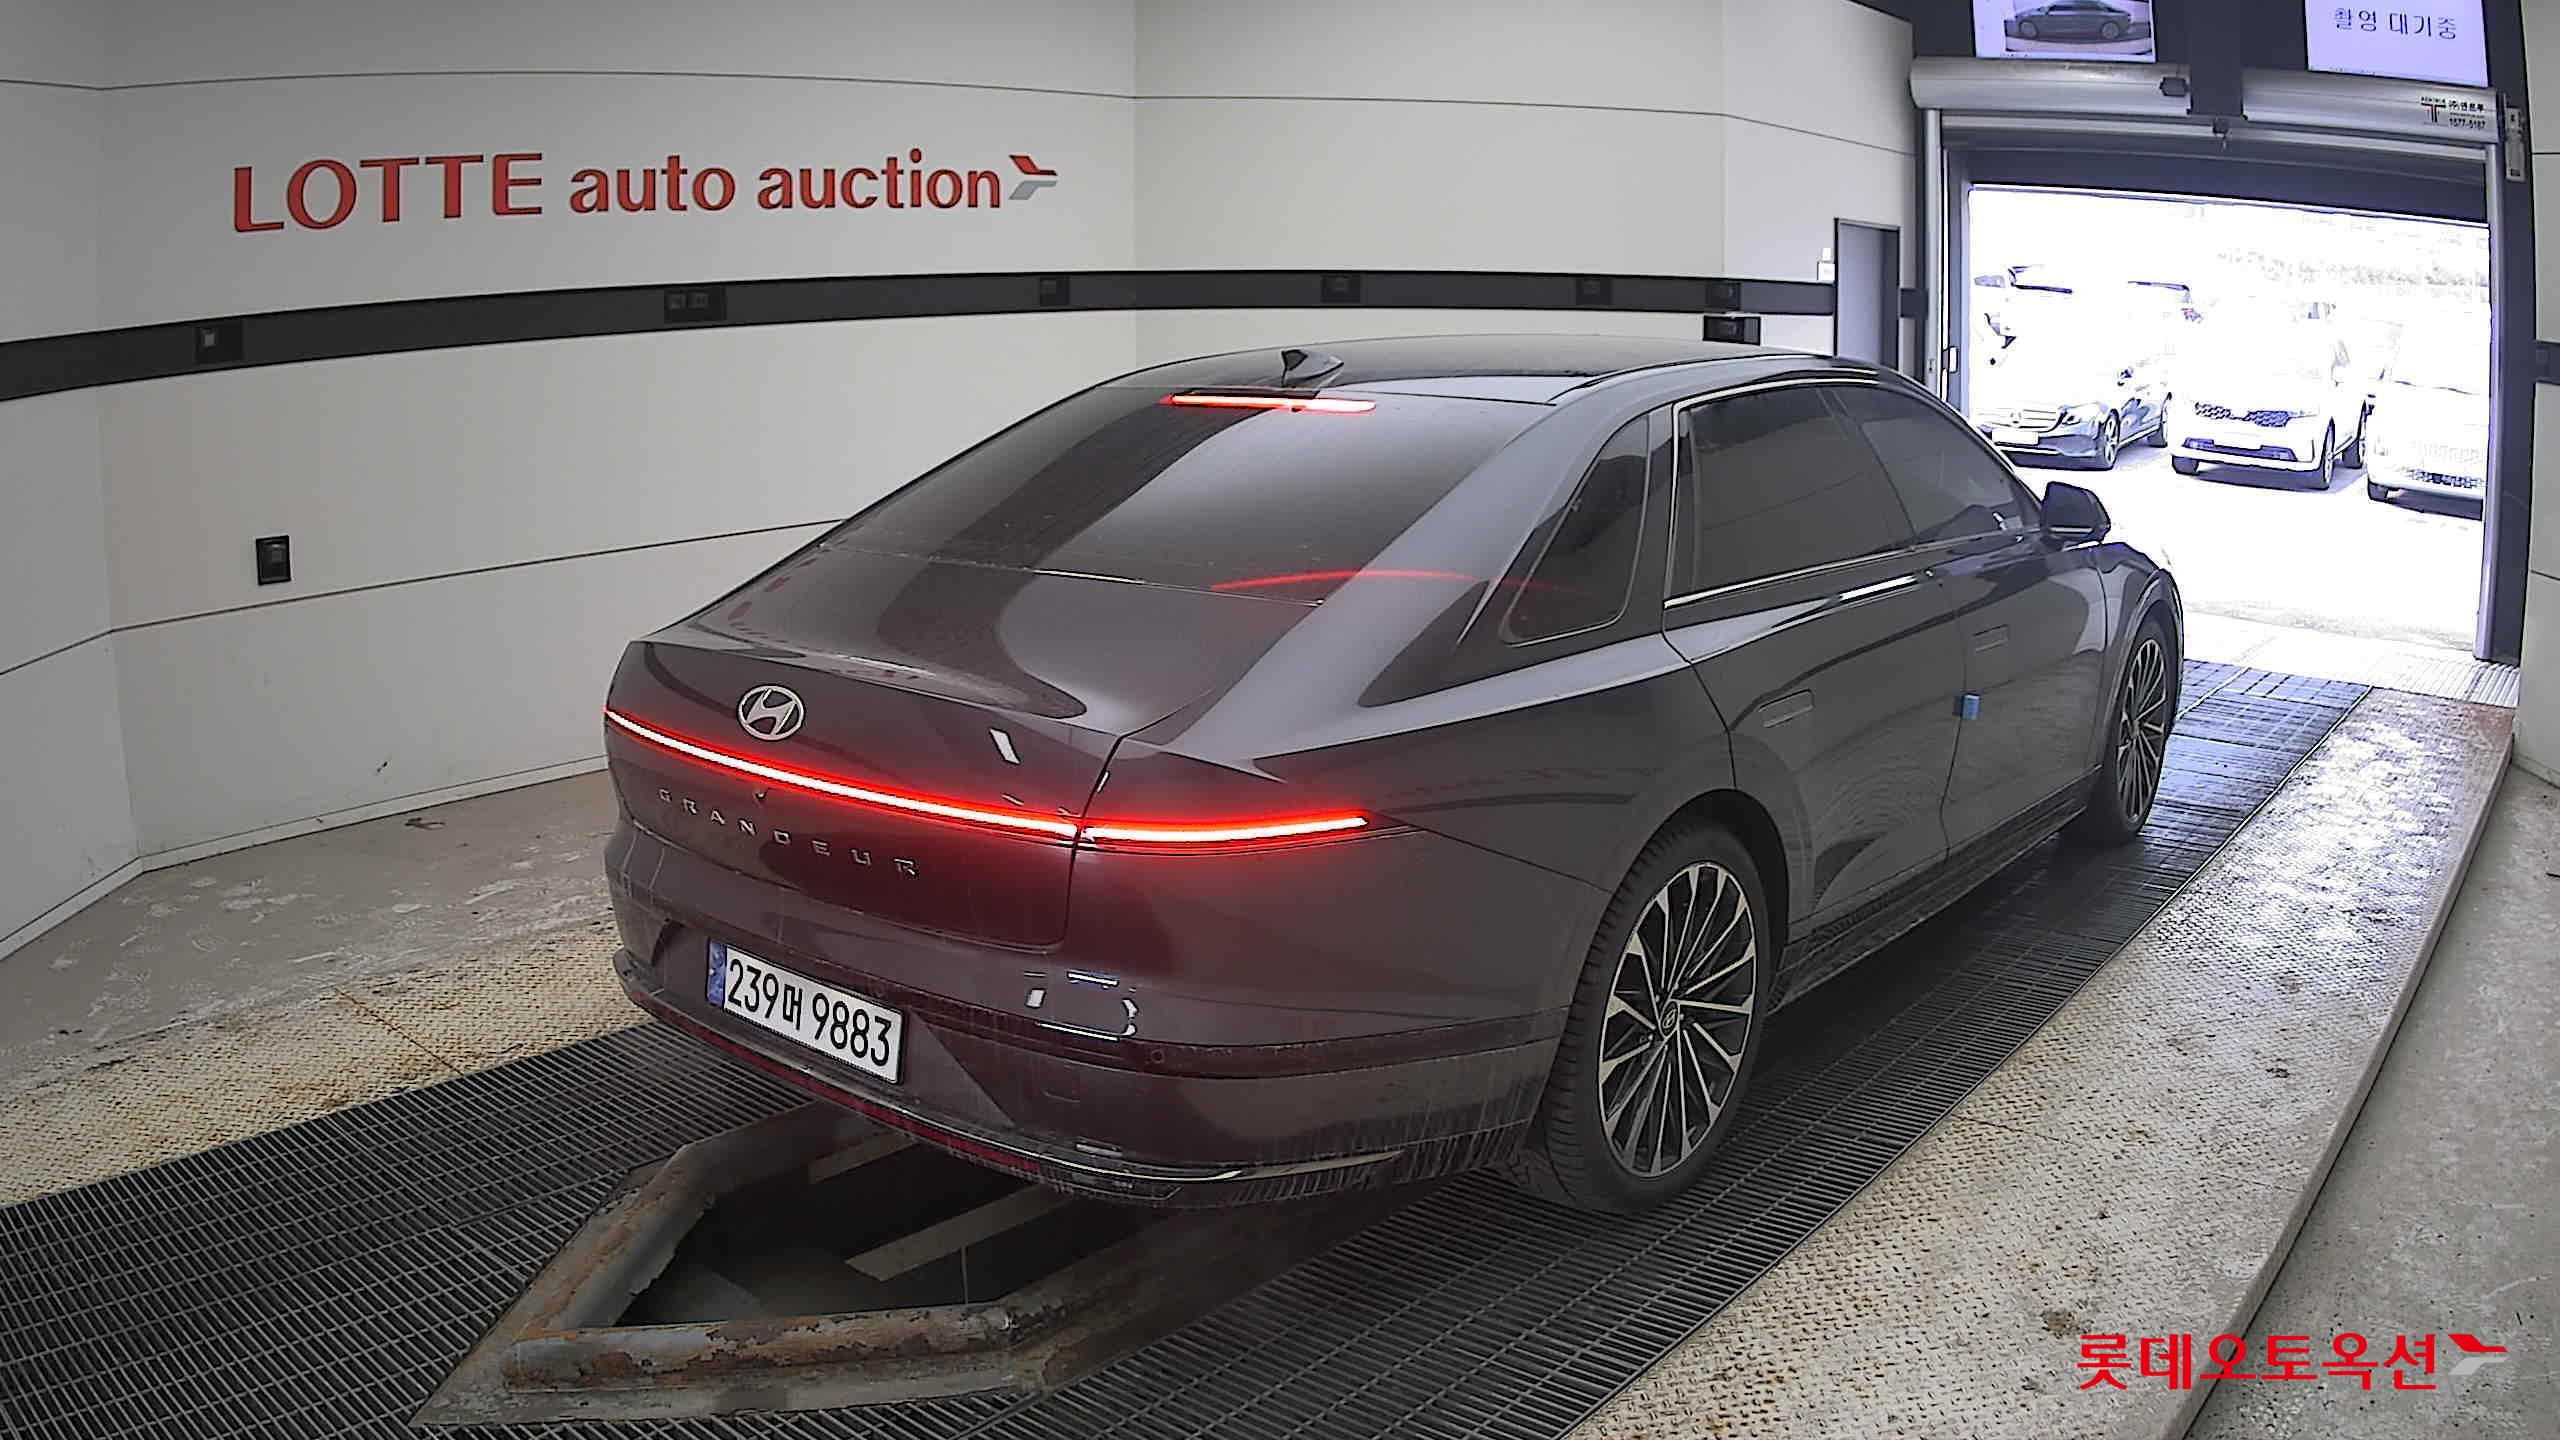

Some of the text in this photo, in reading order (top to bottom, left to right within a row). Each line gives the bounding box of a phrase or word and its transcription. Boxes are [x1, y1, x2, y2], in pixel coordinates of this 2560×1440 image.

[2389, 12, 2456, 39] 대기중
[234, 147, 1001, 233] LOTTE auto auction
[658, 788, 918, 877] GRANDEUR
[812, 993, 892, 1067] 9883
